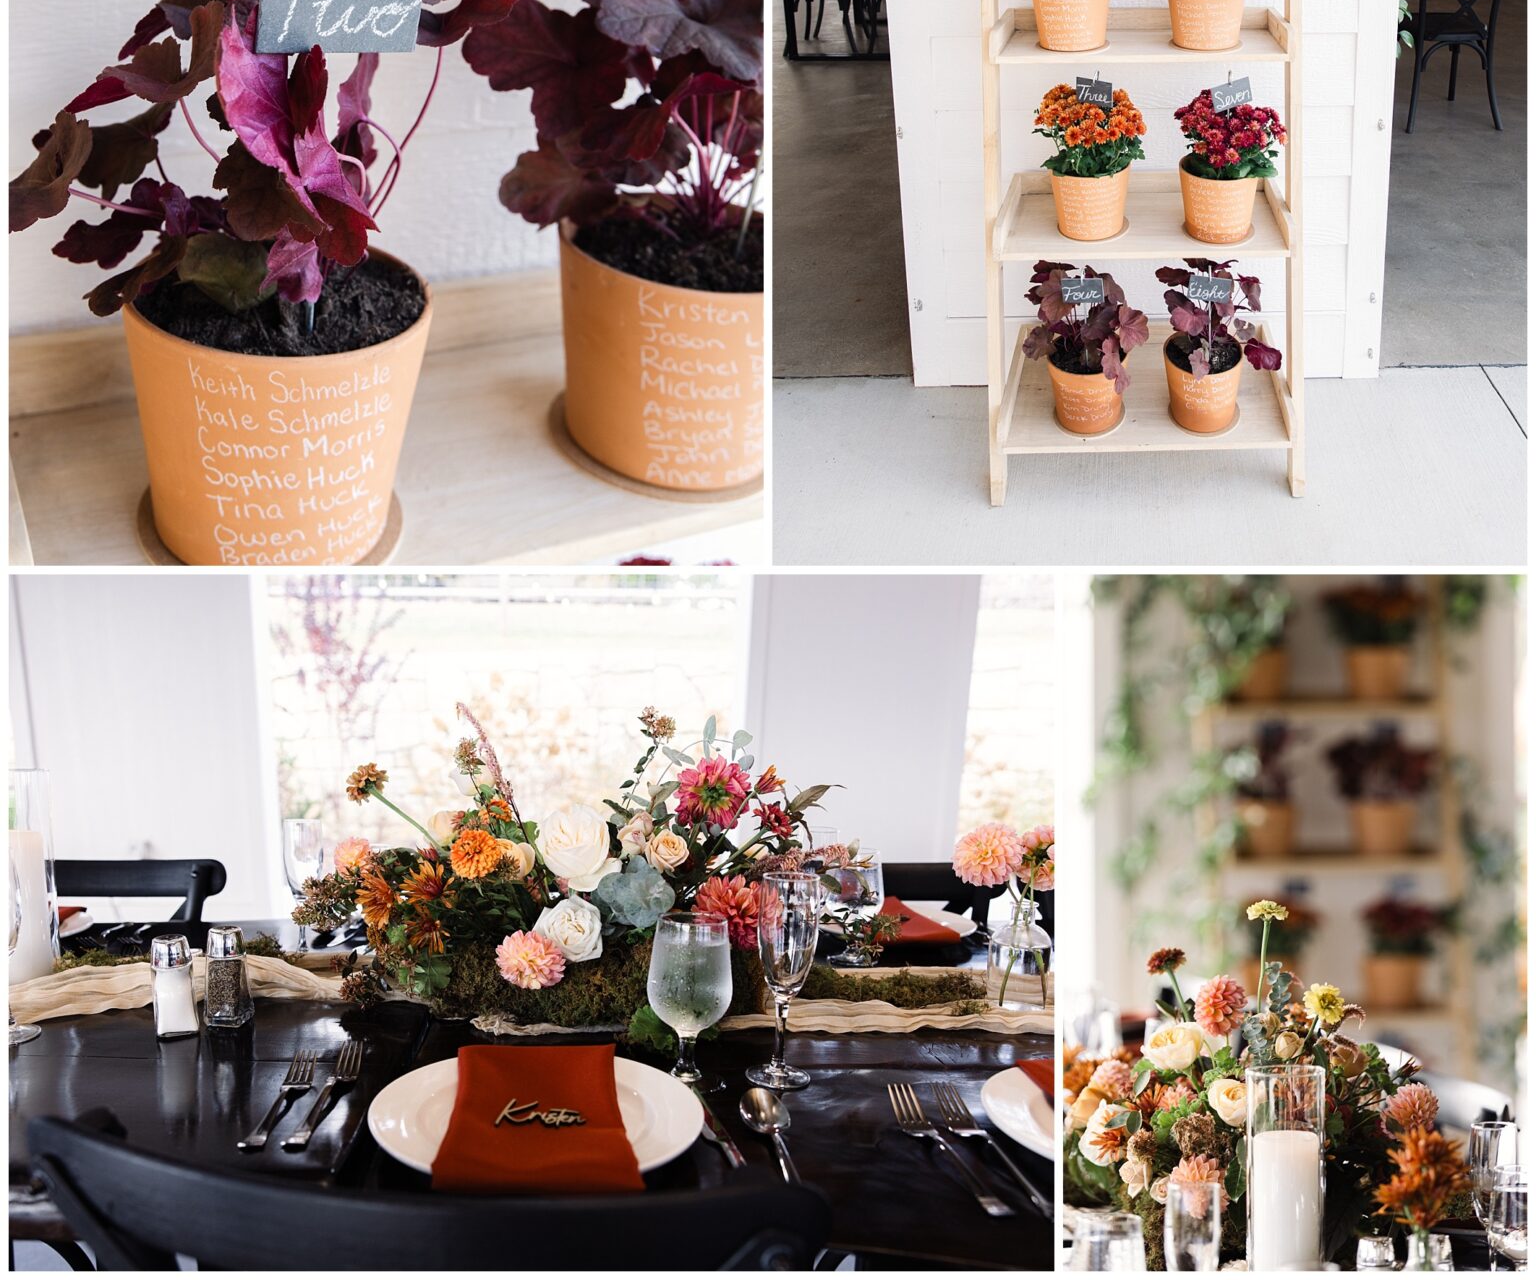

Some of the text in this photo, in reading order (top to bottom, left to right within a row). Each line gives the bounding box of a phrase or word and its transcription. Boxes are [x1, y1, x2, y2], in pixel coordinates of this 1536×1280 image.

[1077, 84, 1111, 104] Three
[1214, 88, 1251, 109] Seven
[1062, 286, 1101, 301] Four
[1188, 281, 1229, 300] Eight
[638, 286, 750, 325] Kristen
[639, 321, 725, 350] Jason
[640, 346, 738, 377] Rachel
[187, 358, 391, 404] Keith Schmelzle
[640, 371, 741, 400] Michael
[194, 391, 392, 435] Kale Schmelzle
[643, 400, 733, 433] Ashley
[198, 419, 386, 459] Connor Morris
[647, 442, 730, 466] John
[201, 456, 301, 496] Sophie
[646, 463, 712, 487] Anne
[206, 494, 285, 520] Tina
[213, 523, 306, 547] Owen
[218, 545, 317, 566] Braden
[495, 1098, 587, 1126] Kristen
